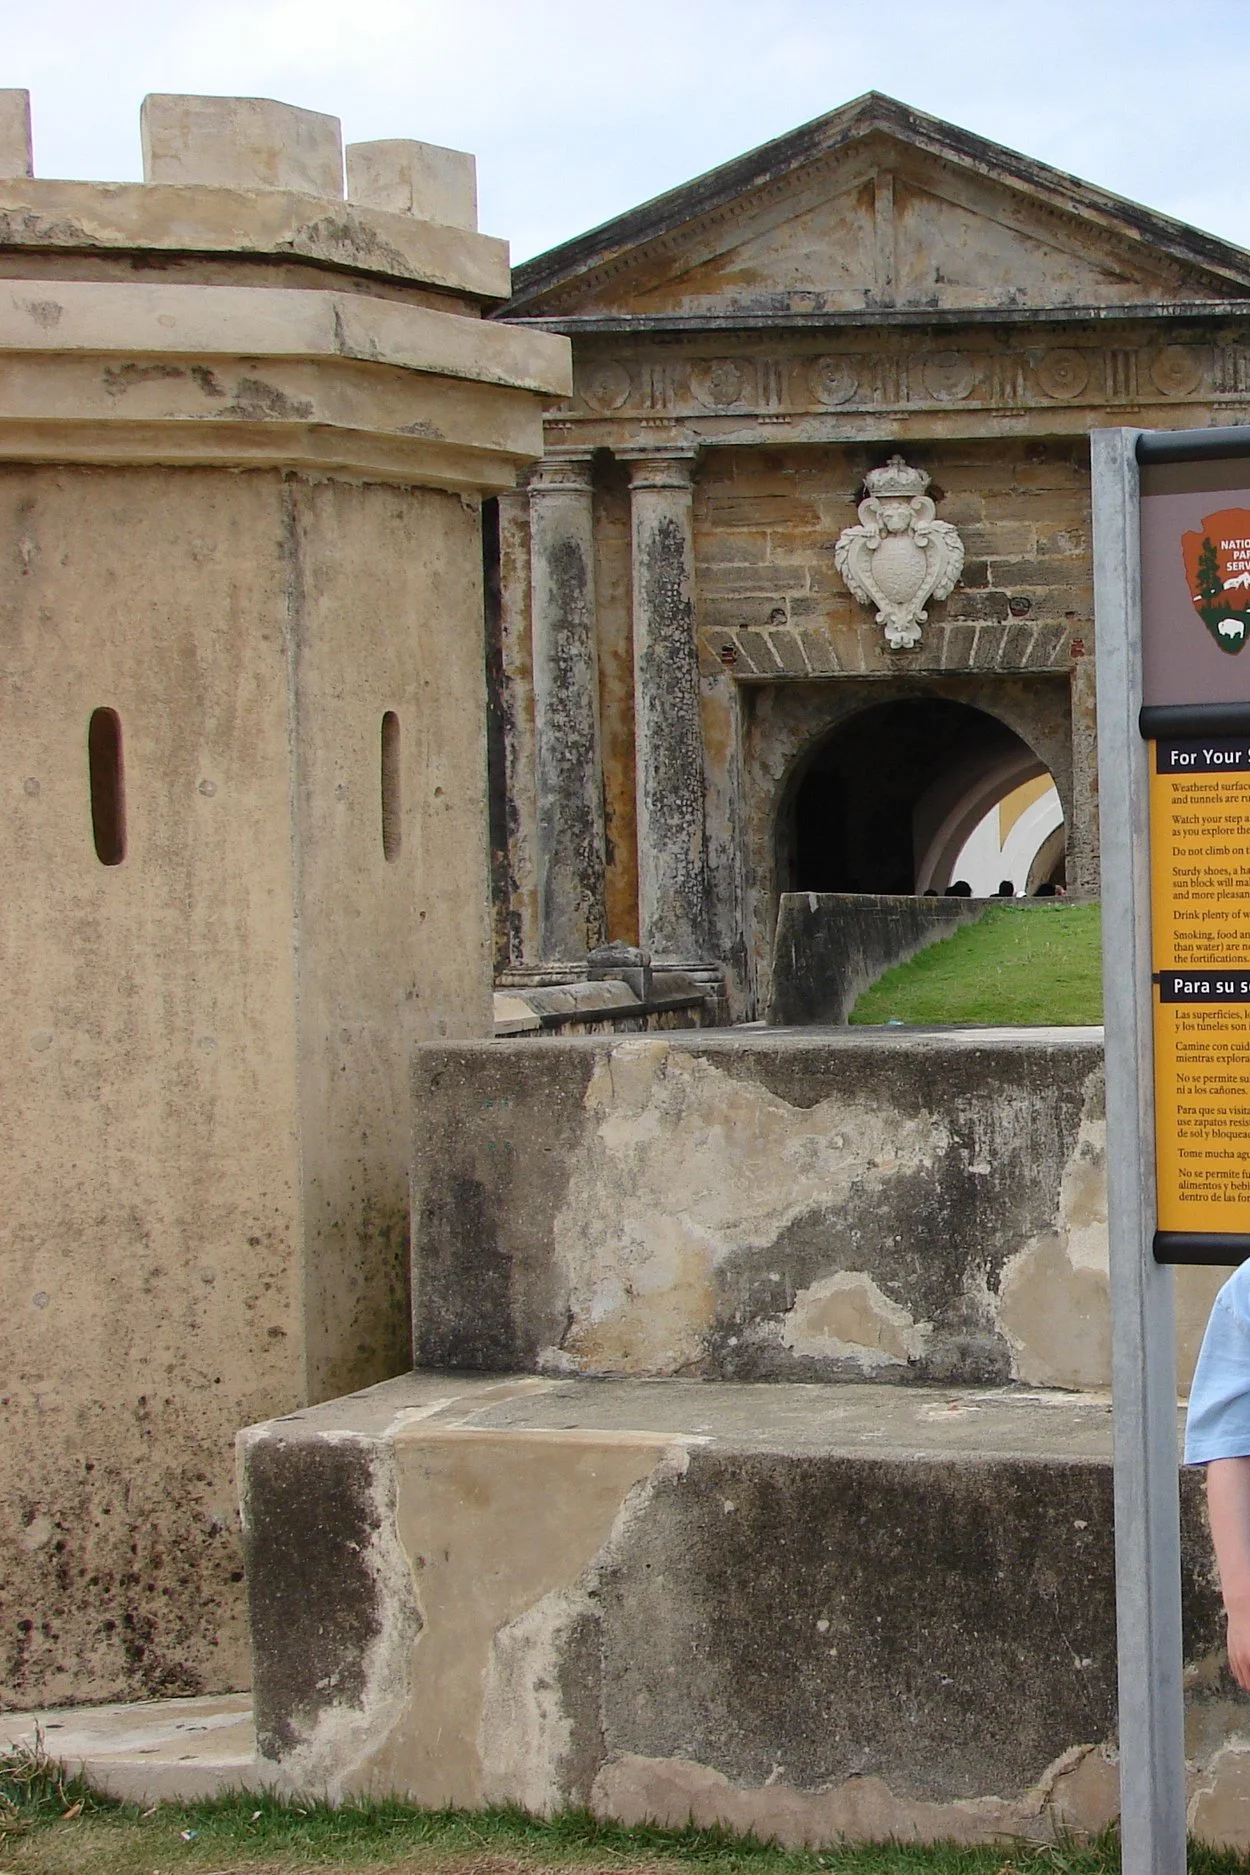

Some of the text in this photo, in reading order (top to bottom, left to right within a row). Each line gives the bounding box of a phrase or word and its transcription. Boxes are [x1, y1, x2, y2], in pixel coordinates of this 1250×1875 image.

[1170, 750, 1197, 765] For
[1202, 748, 1242, 764] Your
[1170, 781, 1219, 792] Weathered
[1171, 794, 1188, 804] and
[1189, 793, 1223, 804] tunnels
[1224, 795, 1239, 803] are
[1171, 813, 1200, 824] Watch
[1201, 815, 1222, 826] your
[1224, 815, 1242, 825] step
[1171, 828, 1181, 836] as
[1182, 828, 1199, 838] you
[1200, 825, 1235, 837] explore
[1236, 825, 1250, 834] the
[1172, 846, 1186, 856] Do
[1187, 847, 1203, 856] not
[1204, 845, 1230, 855] climb
[1231, 847, 1244, 855] on
[1173, 909, 1200, 920] Drink
[1201, 909, 1229, 922] plenty
[1231, 909, 1241, 919] of
[1173, 929, 1215, 941] Smoking,
[1216, 929, 1238, 939] food
[1173, 954, 1250, 963] the fortifications.
[1174, 978, 1210, 993] Para
[1215, 981, 1234, 993] su
[1175, 1009, 1190, 1019] Las
[1192, 1009, 1242, 1021] superficies,
[1176, 1084, 1185, 1094] ni
[1194, 1084, 1207, 1094] los
[1208, 1084, 1248, 1095] cañones.
[1176, 1119, 1192, 1130] use
[1193, 1118, 1227, 1130] zapatos
[1176, 1148, 1203, 1158] Tome
[1204, 1149, 1235, 1158] mucha
[1178, 1192, 1209, 1201] dentro
[1210, 1192, 1222, 1202] de
[1223, 1192, 1236, 1202] las
